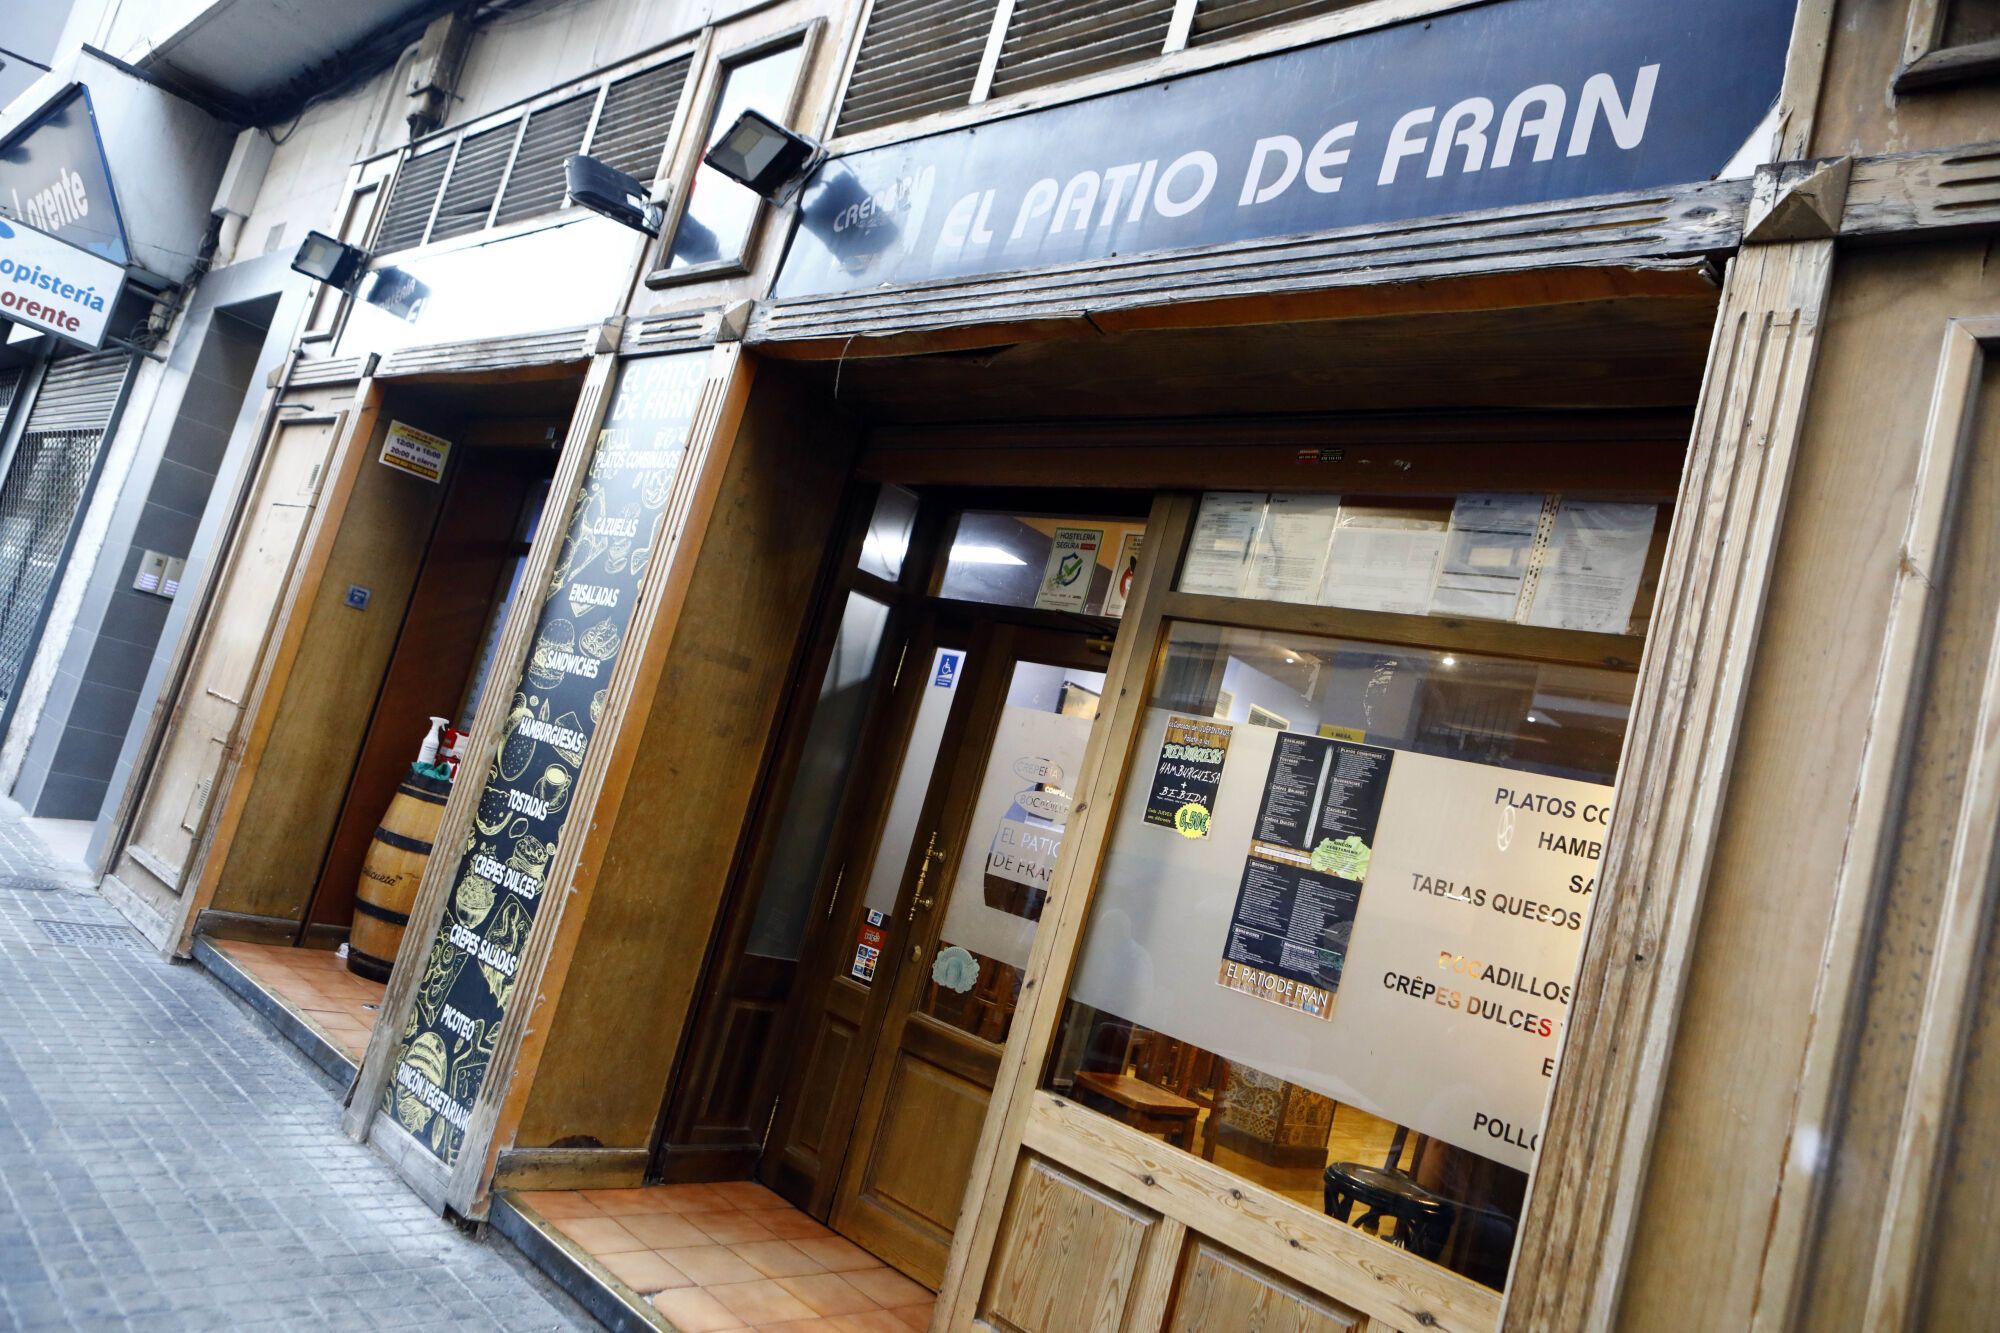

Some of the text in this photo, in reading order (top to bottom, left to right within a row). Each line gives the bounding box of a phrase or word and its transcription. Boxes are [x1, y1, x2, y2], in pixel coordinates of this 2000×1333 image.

[940, 64, 1661, 249] EL PATIO DE FRAN
[11, 167, 89, 232] Lorente
[0, 258, 105, 313] opistería
[0, 291, 80, 332] orente
[643, 358, 706, 392] PATIO
[641, 388, 698, 420] FRAN
[593, 516, 639, 538] CAZUELAS
[1055, 541, 1080, 550] SEGURA
[568, 583, 621, 608] ENSALADAS
[545, 650, 600, 679] SANDWICHES
[517, 716, 586, 753] HAMBURGUESAS
[1159, 762, 1221, 784] HAMBURGUESA
[507, 788, 550, 822] TOSTADAS
[1159, 787, 1207, 804] BEBIDA
[1495, 787, 1610, 826] PLATOS CO
[1001, 827, 1015, 846] EL
[1538, 831, 1602, 860] HAMB
[993, 852, 1014, 871] DE
[504, 867, 538, 900] DULCES
[1568, 874, 1594, 896] SA
[1411, 873, 1582, 931] TABLAS QUESOS
[476, 939, 517, 977] SALADAS
[1226, 962, 1239, 979] EL
[1241, 967, 1277, 991] PATIO
[1276, 978, 1293, 996] DE
[1295, 984, 1329, 1008] FRAN
[1383, 971, 1553, 1037] CRÊPES DULCES
[440, 1003, 475, 1042] PICOTEO
[397, 1061, 426, 1097] RINCÓN
[1541, 1057, 1555, 1078] E
